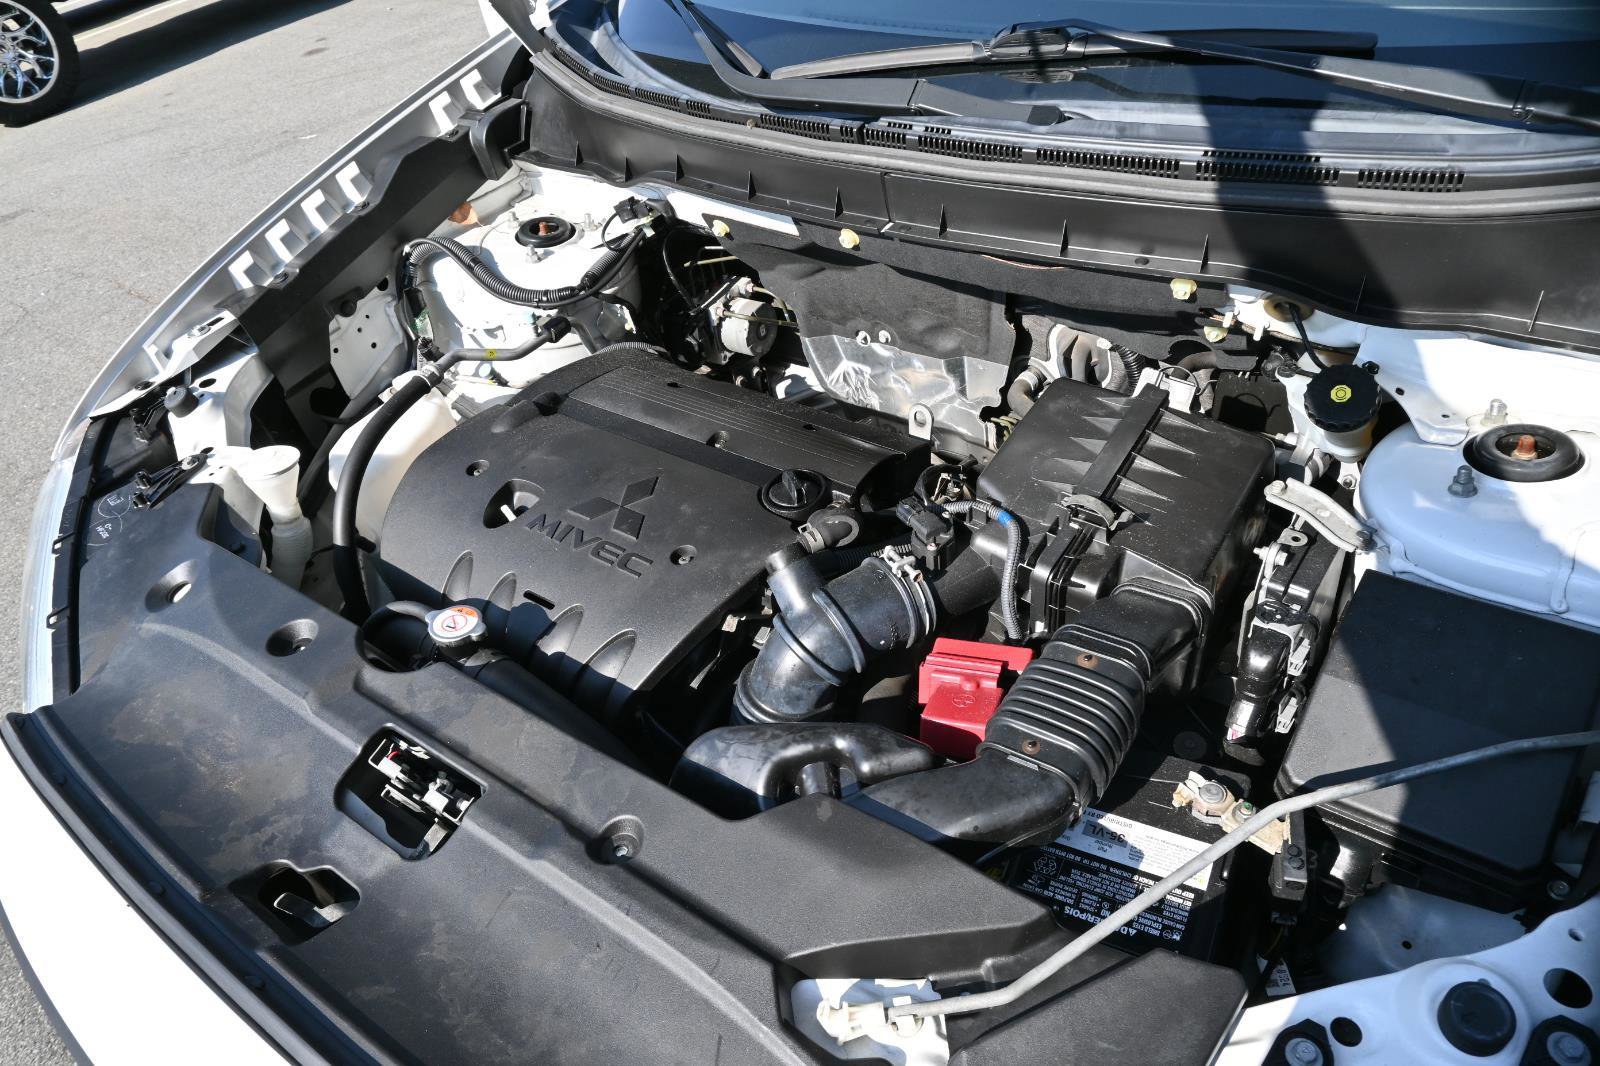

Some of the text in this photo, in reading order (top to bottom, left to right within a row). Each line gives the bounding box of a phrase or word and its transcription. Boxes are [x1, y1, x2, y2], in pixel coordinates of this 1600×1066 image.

[526, 513, 654, 578] MIVEC
[1181, 890, 1194, 899] KEEP
[1131, 921, 1144, 930] EYES
